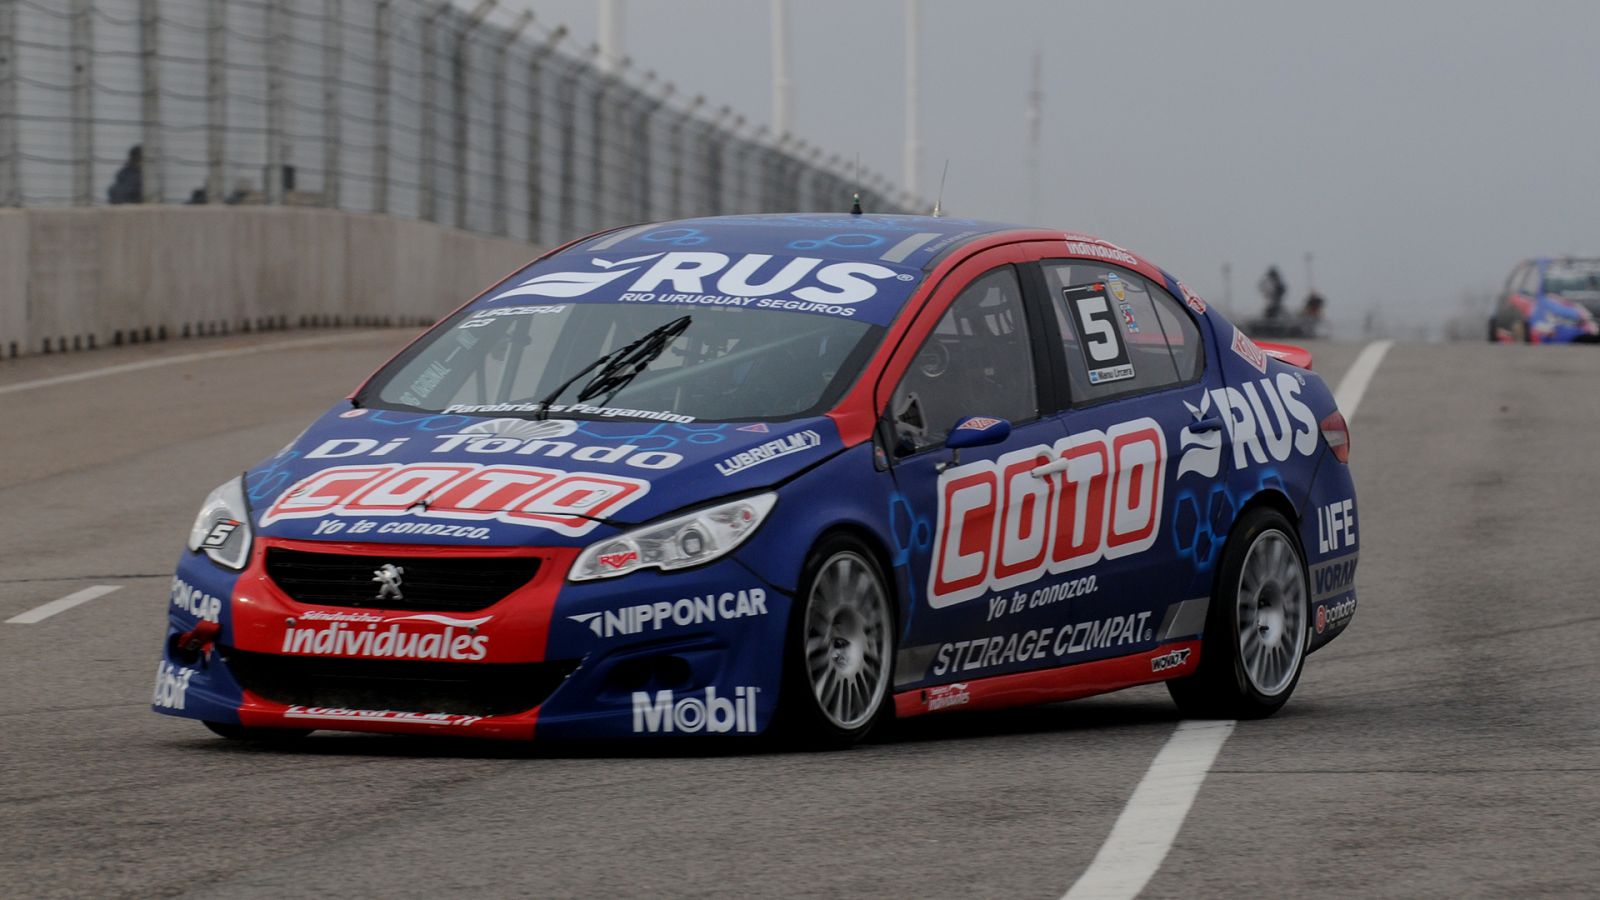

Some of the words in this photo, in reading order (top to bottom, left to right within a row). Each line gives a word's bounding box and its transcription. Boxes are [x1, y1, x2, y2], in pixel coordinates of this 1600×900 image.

[628, 251, 898, 304] RUS
[618, 292, 656, 302] RIO
[657, 293, 755, 307] URUGUAY
[756, 298, 857, 317] SEGUROS
[1076, 296, 1120, 361] 5
[441, 402, 560, 415] Parabriss
[564, 403, 697, 424] Pergamino
[1210, 371, 1319, 471] RUS
[303, 437, 411, 459] Di
[430, 432, 685, 470] Tondo
[714, 432, 808, 474] LUBRIFILM
[261, 463, 650, 537] COTO
[926, 416, 1168, 610] COTO
[205, 523, 236, 546] 5
[312, 518, 339, 536] Yo
[350, 518, 373, 534] te
[384, 520, 491, 540] conozco.
[1317, 498, 1356, 554] LIFE
[604, 594, 716, 638] NIPPON
[718, 588, 768, 620] CAR
[986, 595, 1005, 623] Yo
[1009, 590, 1028, 613] te
[1029, 574, 1099, 609] conozco.
[281, 621, 490, 661] individuales
[933, 627, 1055, 676] STORAGE
[1054, 610, 1152, 657] COMPAT
[631, 685, 758, 733] Mobil
